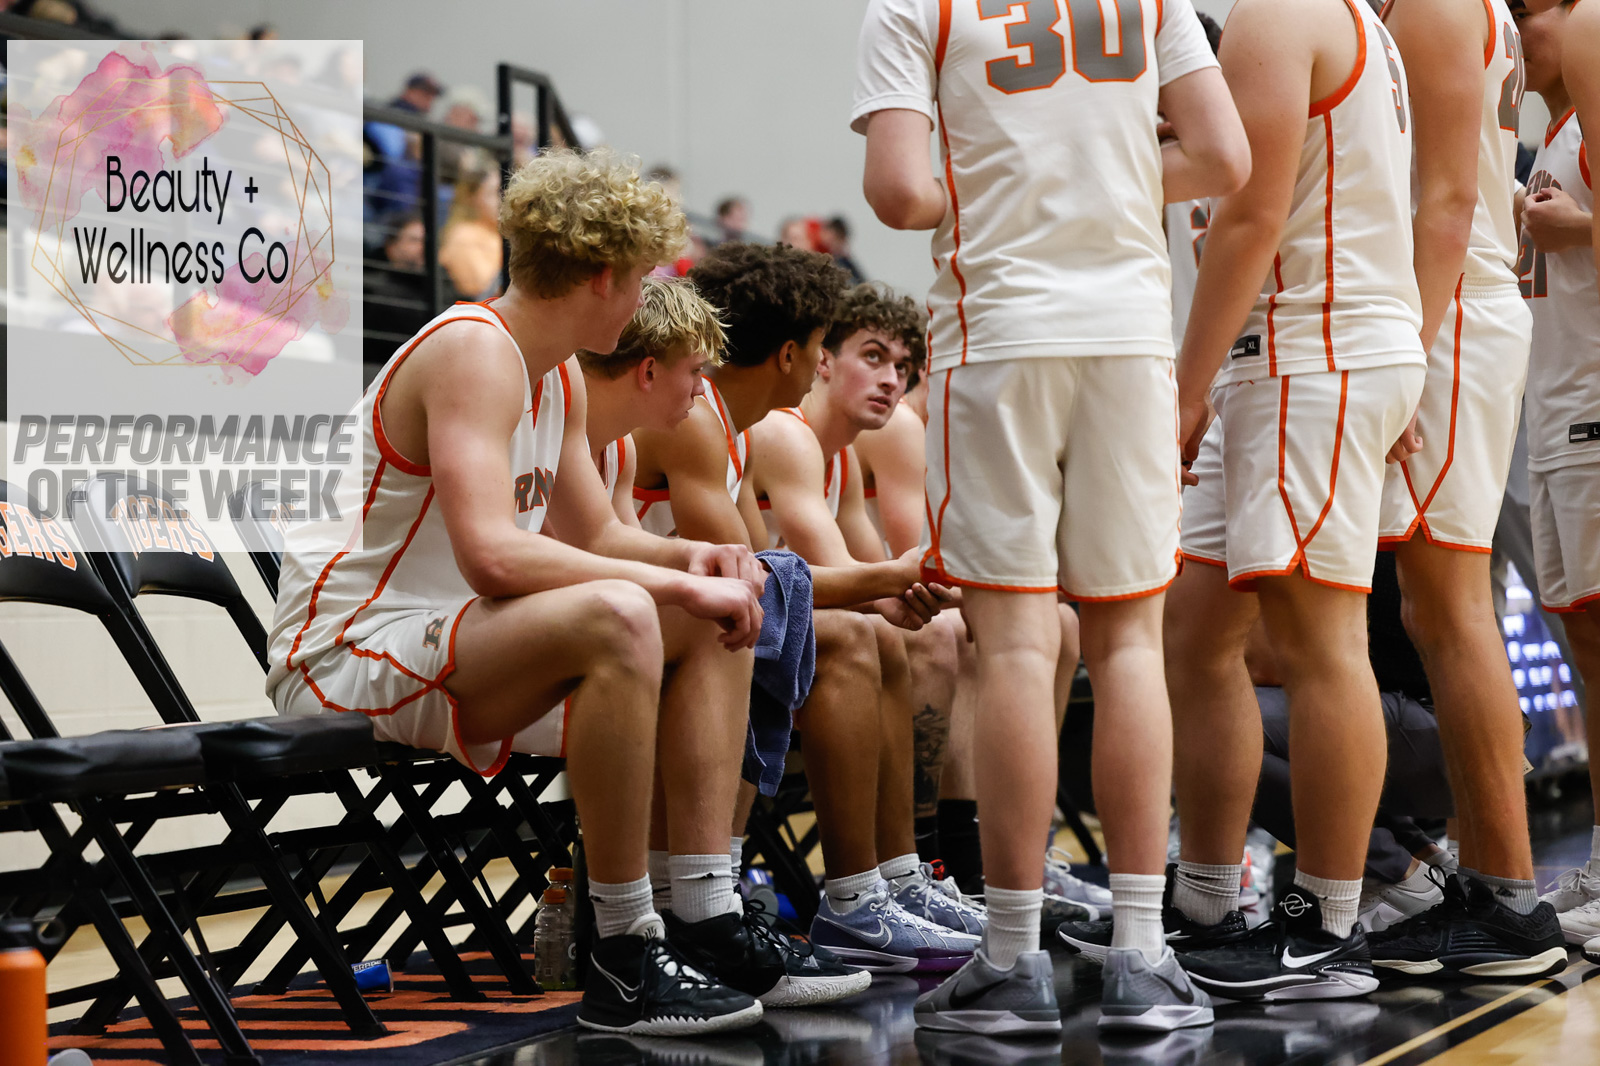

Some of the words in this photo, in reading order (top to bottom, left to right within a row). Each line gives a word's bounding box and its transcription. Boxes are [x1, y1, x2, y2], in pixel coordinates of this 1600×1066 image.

[975, 0, 1148, 95] 30
[1373, 22, 1407, 134] 5
[1247, 340, 1257, 350] XL
[109, 494, 215, 563] TIGERS
